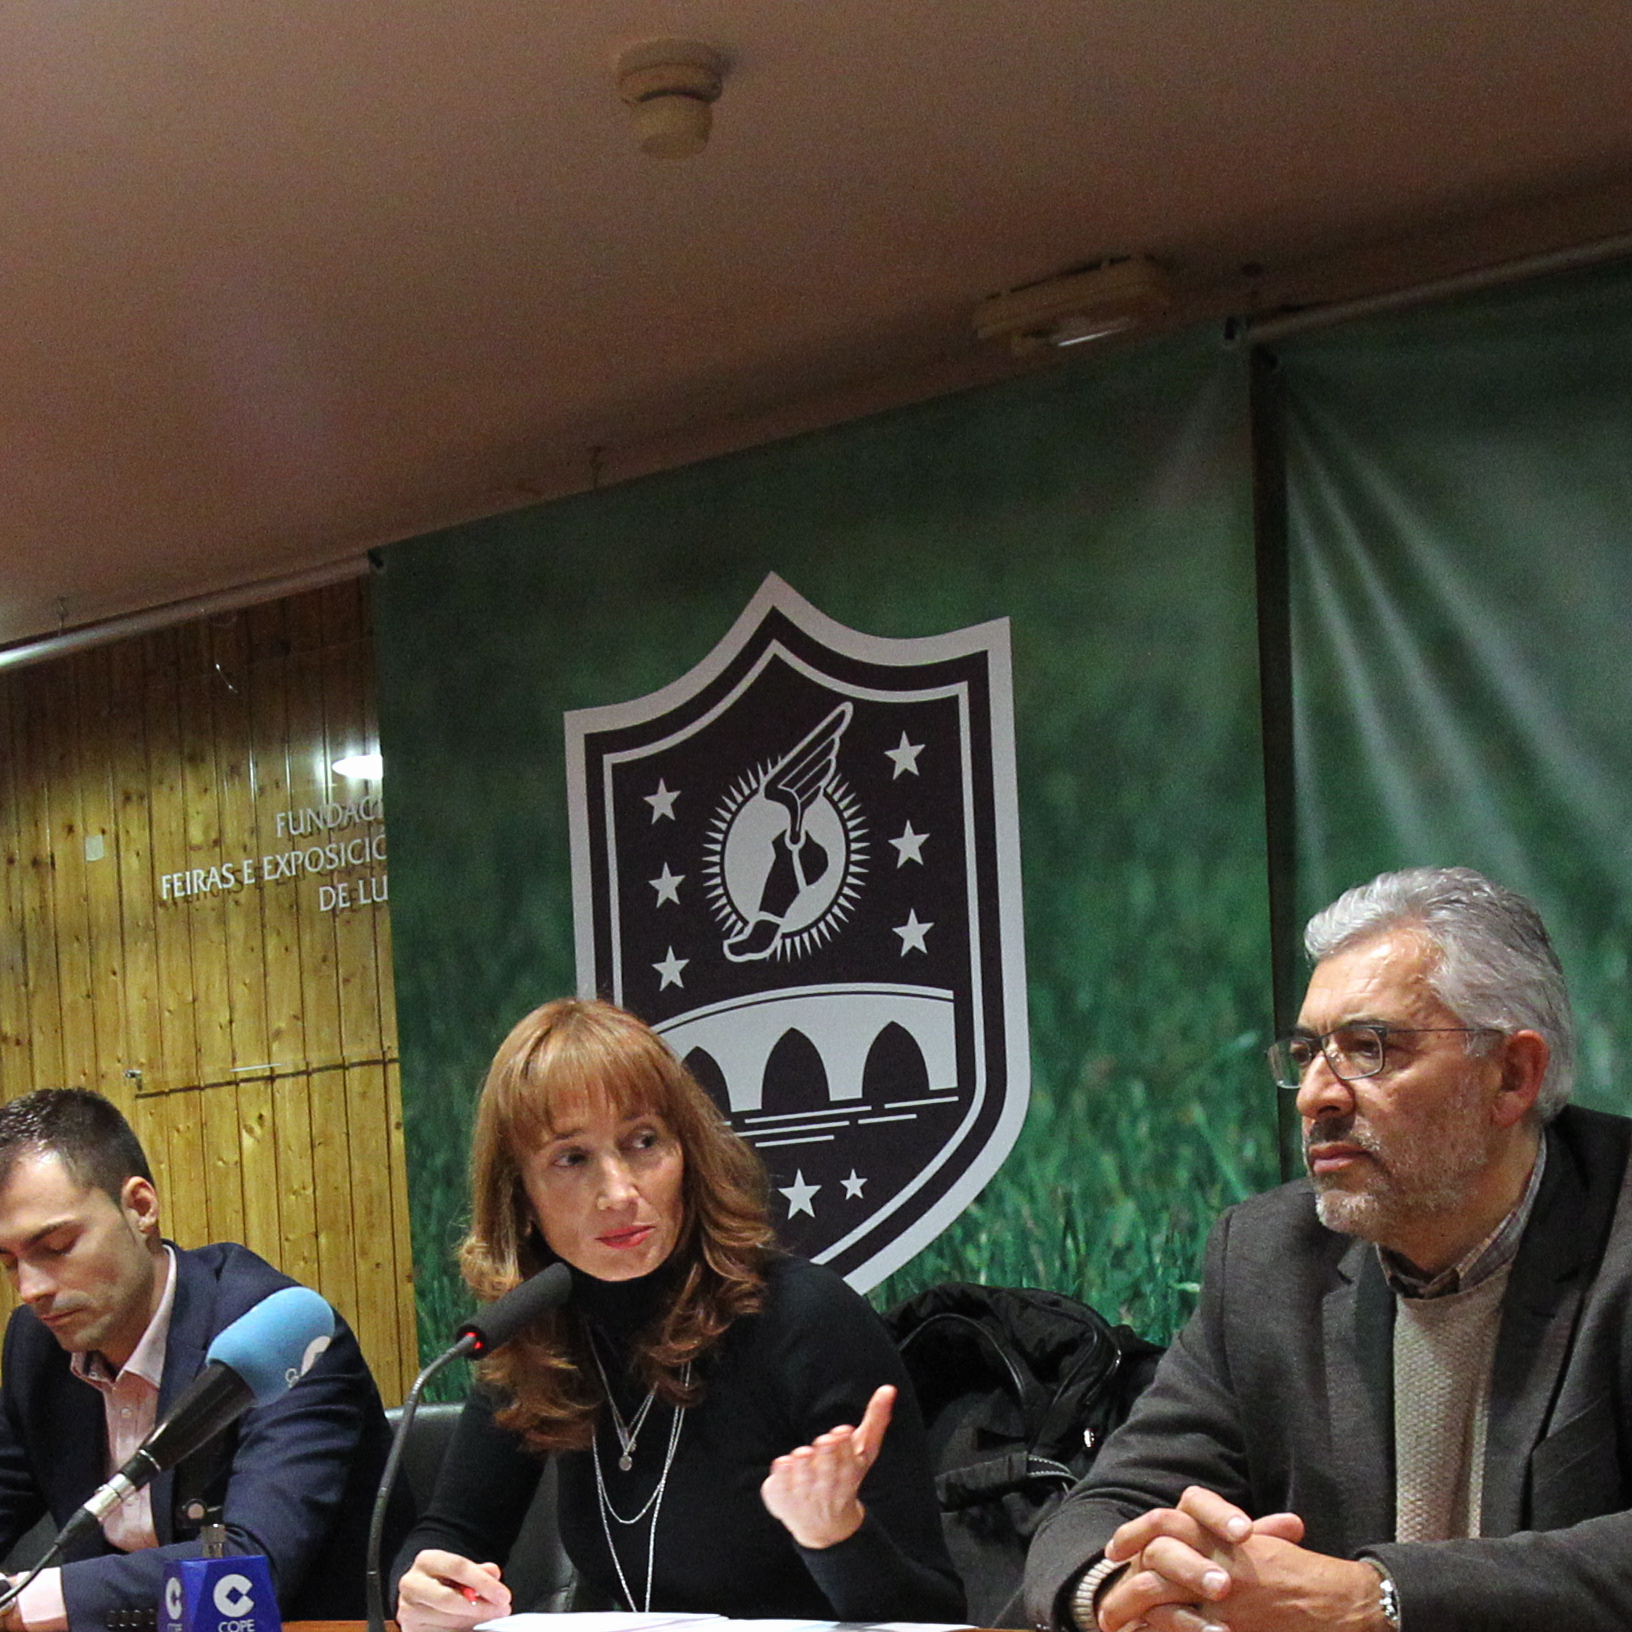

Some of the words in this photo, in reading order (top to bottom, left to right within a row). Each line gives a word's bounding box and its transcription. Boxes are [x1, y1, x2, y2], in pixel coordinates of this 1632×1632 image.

[161, 863, 235, 900] FEIRAS
[242, 859, 257, 885] E
[319, 882, 352, 912] DE
[358, 875, 388, 905] LU
